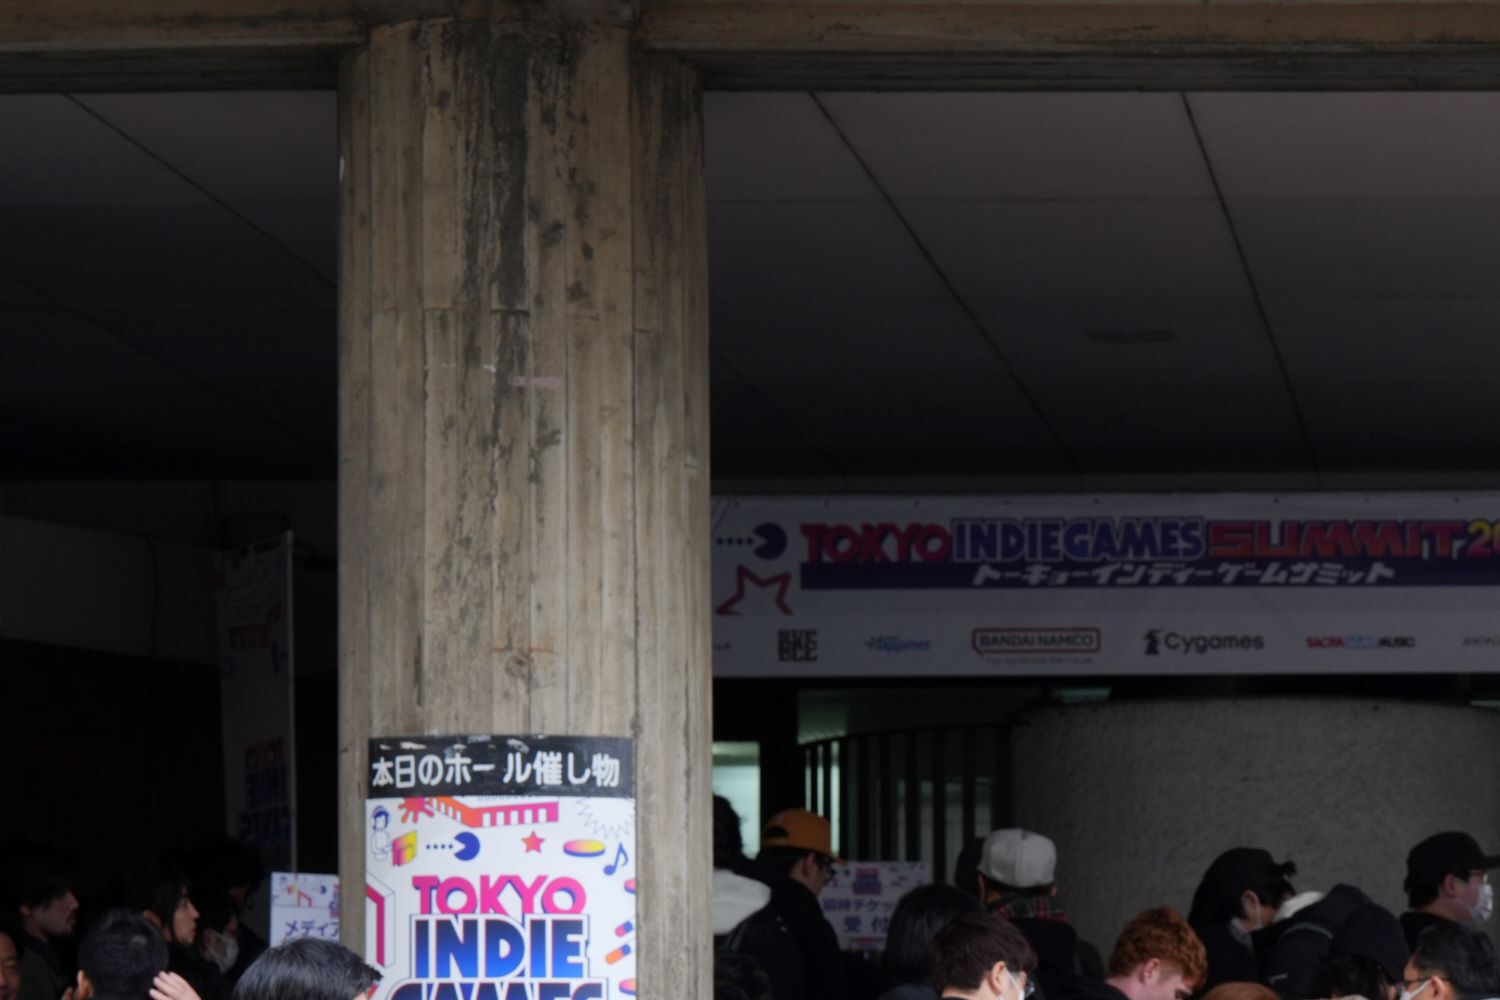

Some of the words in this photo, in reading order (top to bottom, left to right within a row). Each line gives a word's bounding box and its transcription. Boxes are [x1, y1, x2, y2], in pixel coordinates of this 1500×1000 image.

[800, 522, 952, 563] TOKYO
[1208, 519, 1466, 558] SUMMIT
[979, 634, 1034, 647] BANDAI
[1038, 634, 1093, 646] NAMCO
[1164, 631, 1264, 654] Cygames
[372, 751, 620, 788] 本日のホール催し物
[412, 875, 586, 915] TOKYO
[412, 917, 587, 979] INDIE
